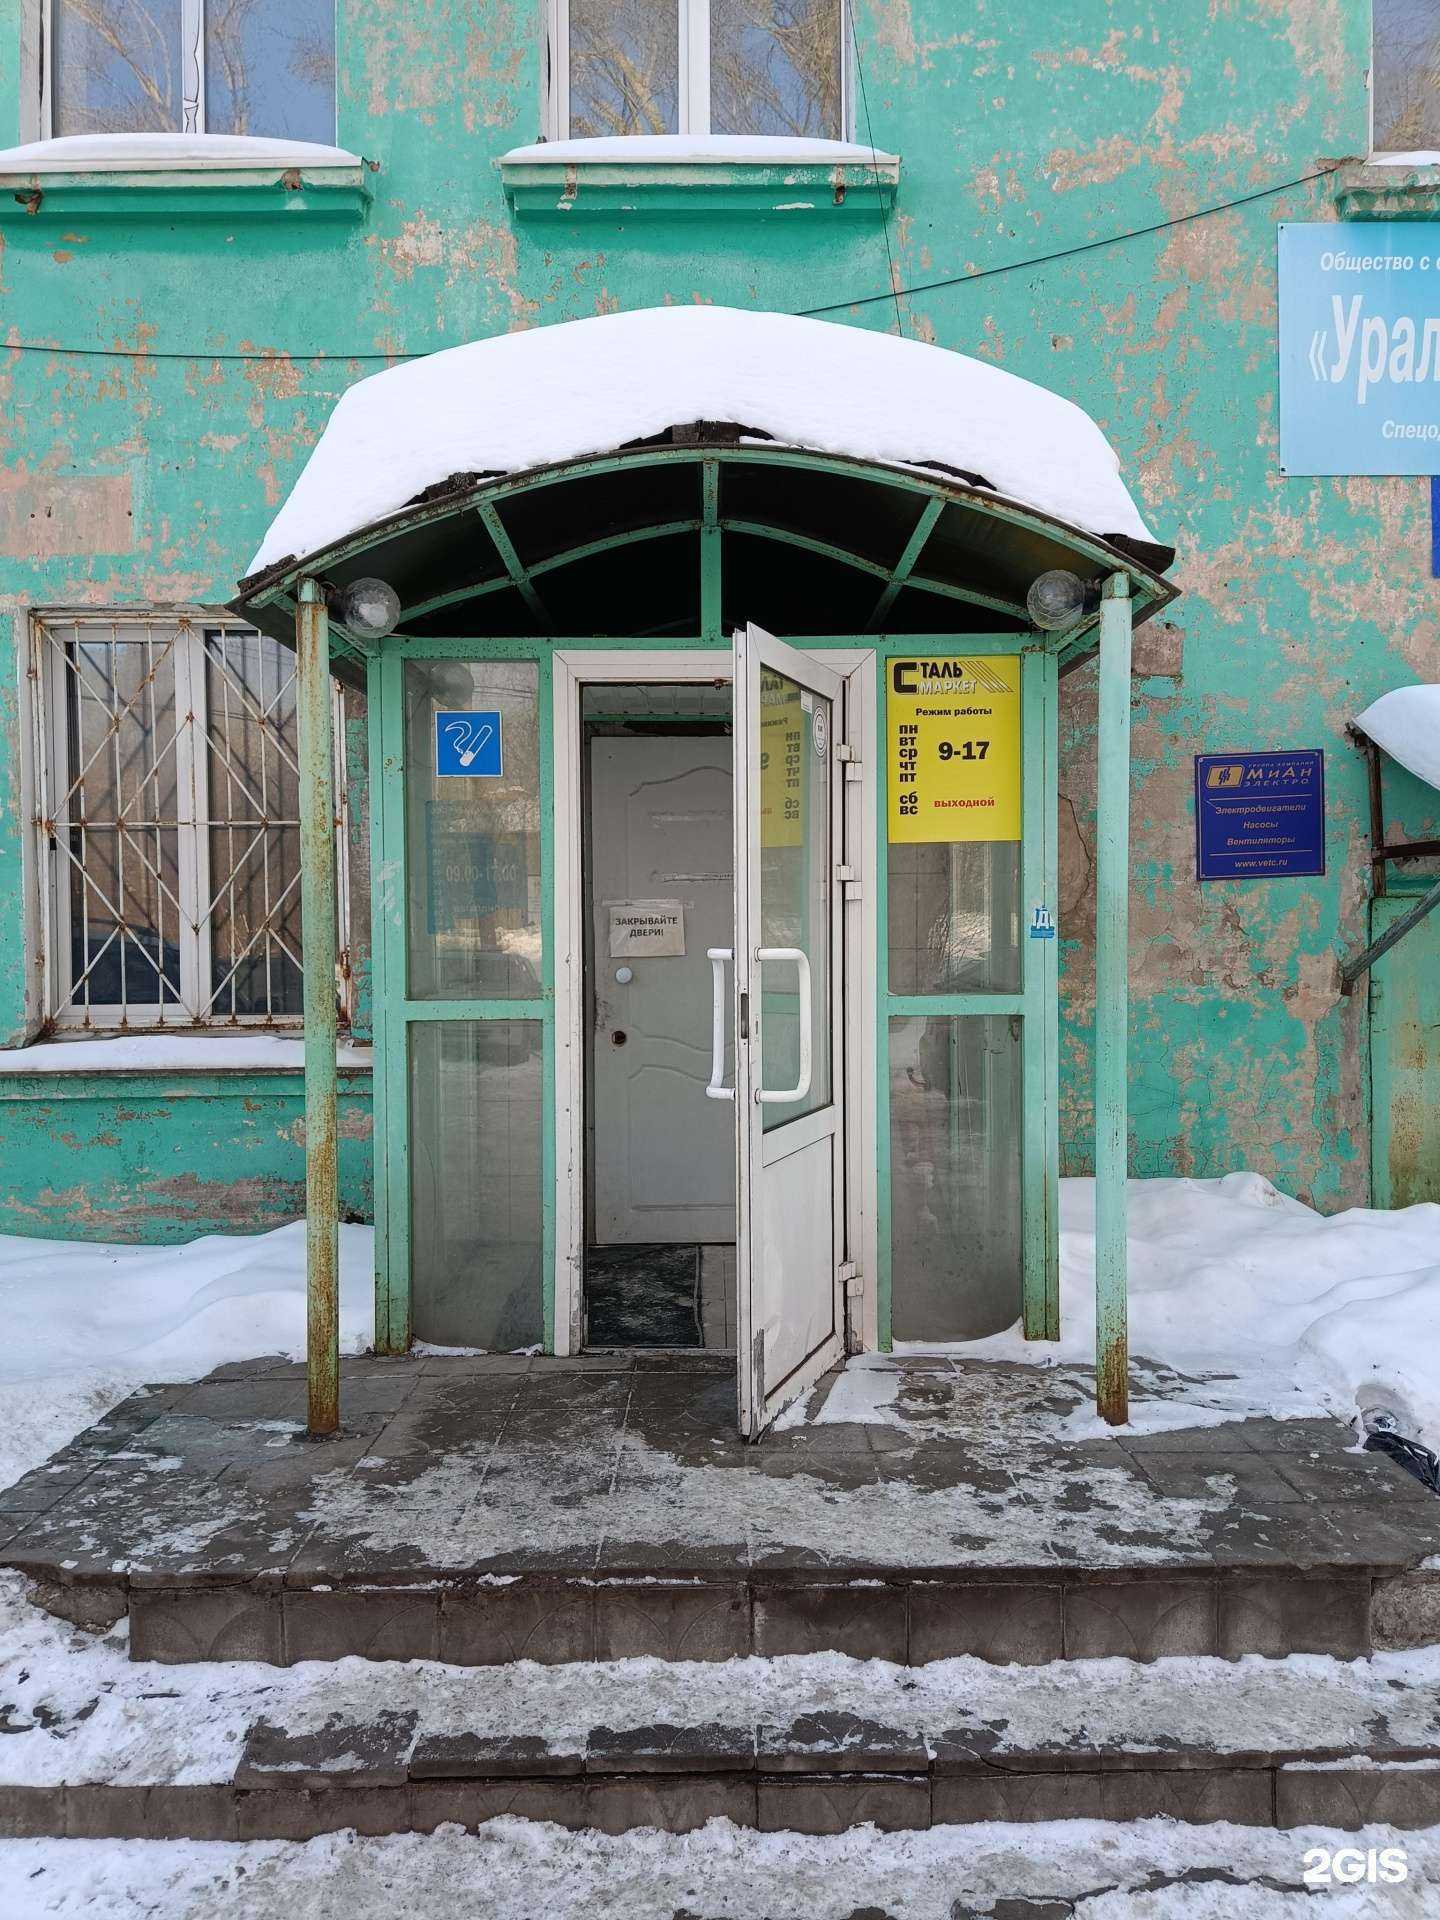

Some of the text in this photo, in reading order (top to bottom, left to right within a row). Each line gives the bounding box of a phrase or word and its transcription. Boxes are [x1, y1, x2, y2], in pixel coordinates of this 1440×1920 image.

[1320, 251, 1413, 274] Общество
[1382, 420, 1440, 441] Спецо
[917, 680, 977, 696] МАРКЕТ
[915, 706, 992, 717] Режим работы
[899, 724, 919, 734] пн
[899, 736, 917, 746] вт
[899, 749, 918, 760] ср
[938, 741, 990, 761] 9-17
[899, 761, 917, 771] чт
[899, 773, 917, 783] пт
[899, 791, 918, 804] сб
[934, 797, 995, 808] выходной
[899, 806, 918, 815] вс
[1215, 804, 1306, 815] Электродвигатели
[1243, 821, 1279, 830] Насосы
[1226, 836, 1296, 846] Вентиляторы
[616, 915, 678, 926] ЗАКРЫВАЙТЕ
[629, 928, 664, 938] ДВЕРИ!
